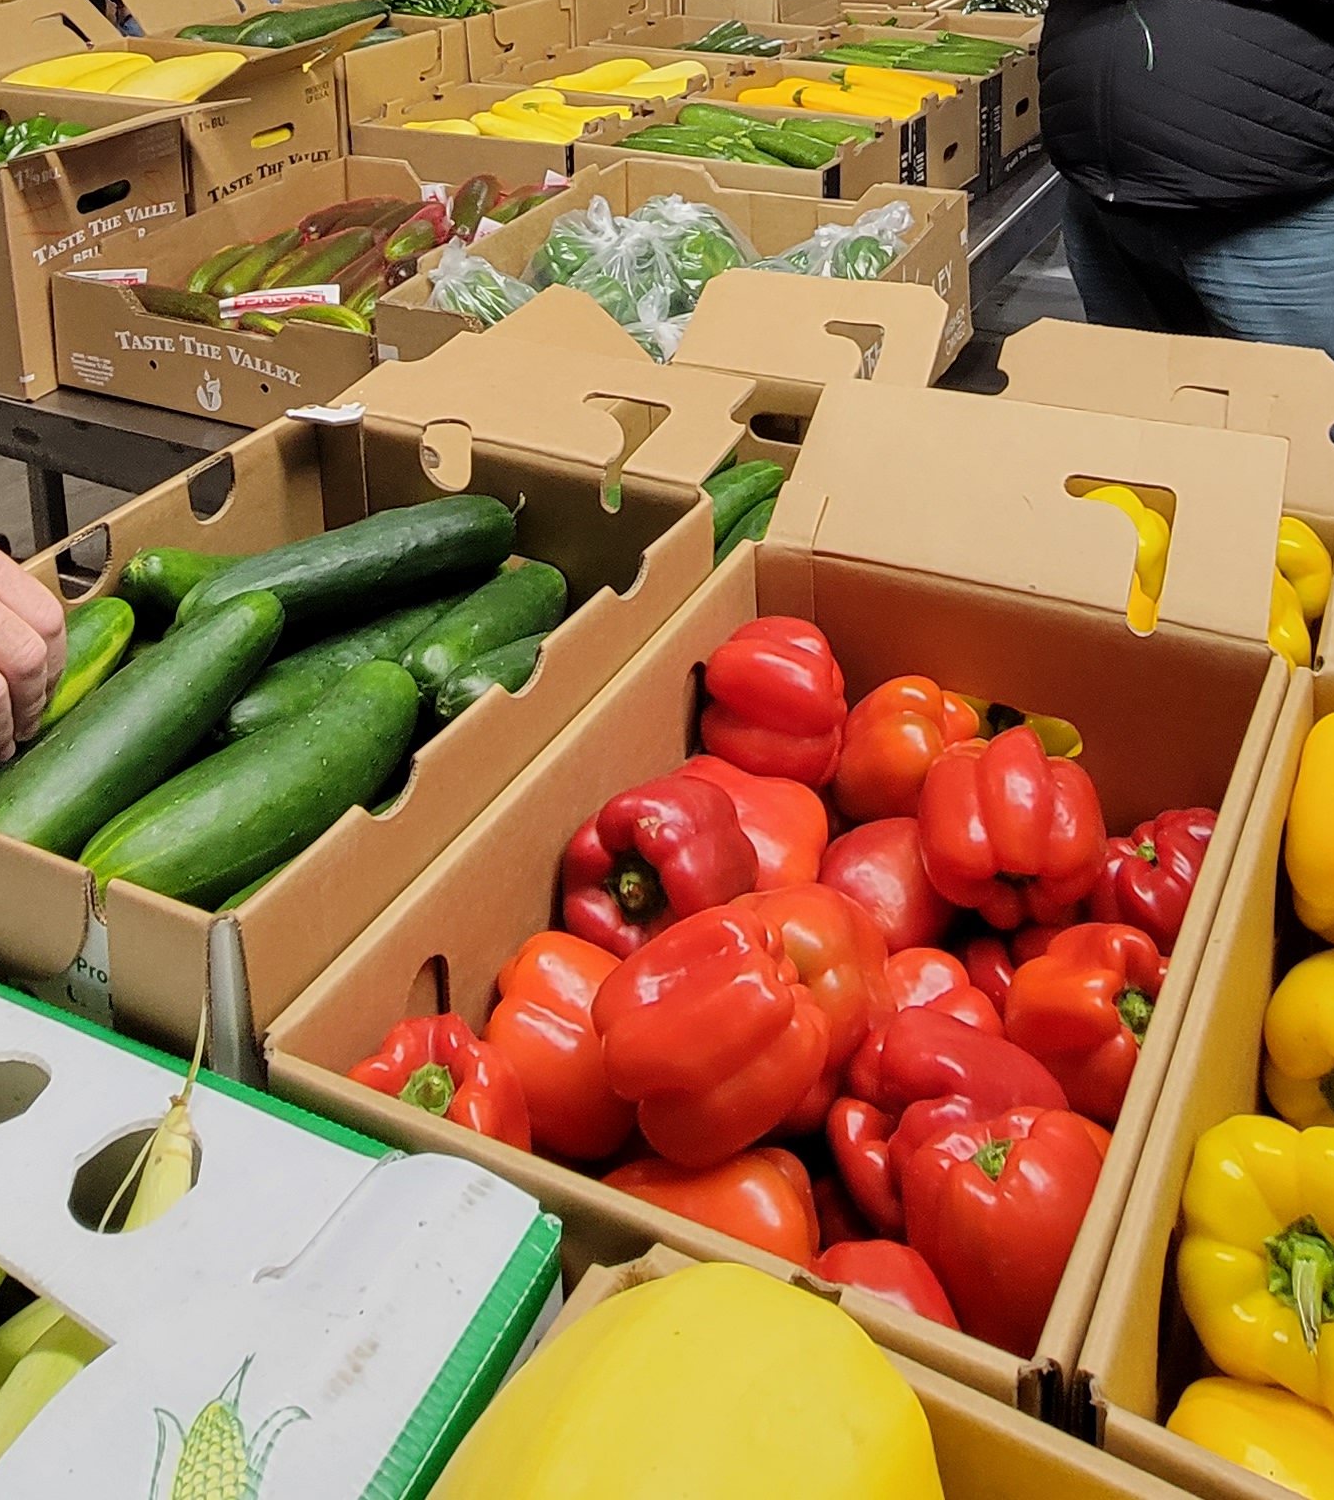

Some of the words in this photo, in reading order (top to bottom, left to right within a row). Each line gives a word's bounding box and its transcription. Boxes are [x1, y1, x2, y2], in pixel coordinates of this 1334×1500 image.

[207, 173, 254, 204] TASTE
[33, 229, 86, 266] TASTE
[88, 216, 122, 238] THE
[124, 201, 177, 224] VALLEY
[115, 330, 175, 353] TASTE
[179, 334, 222, 361] THE
